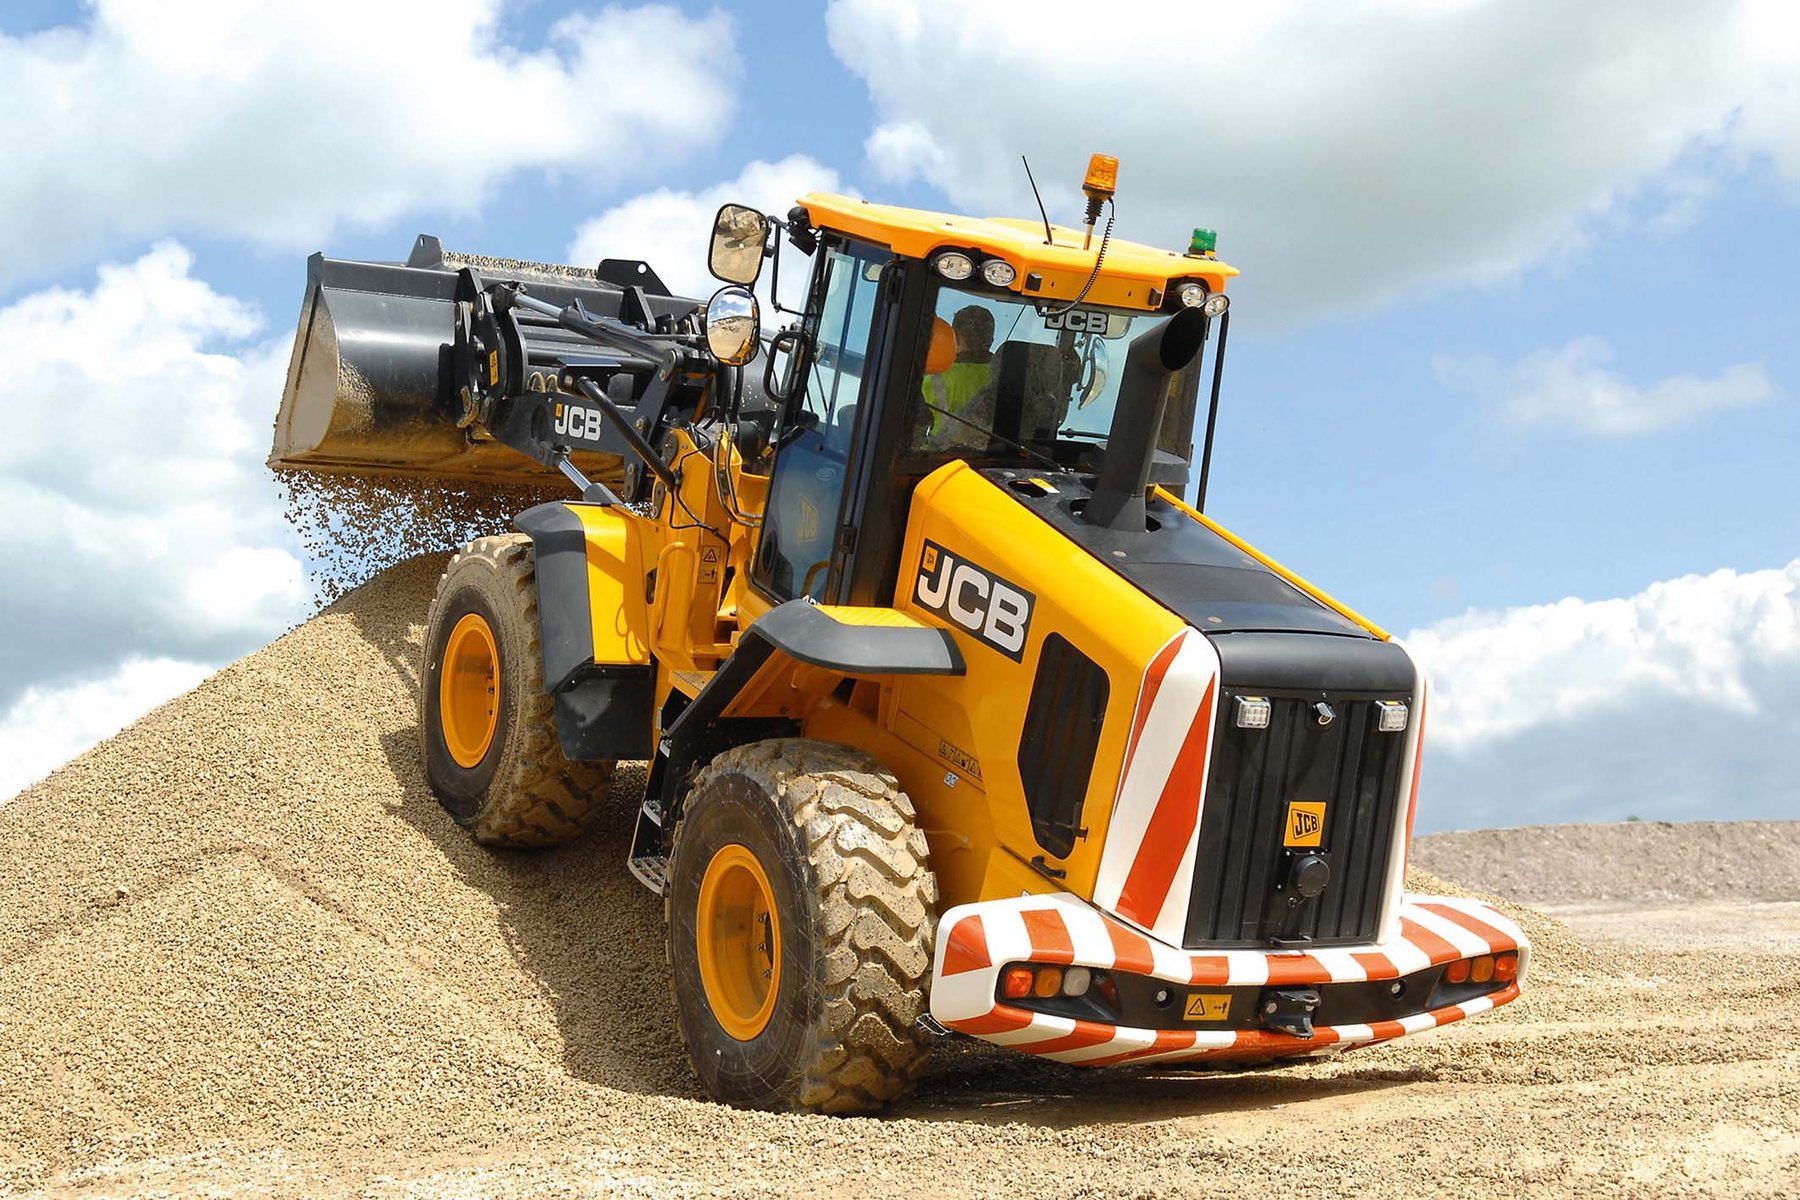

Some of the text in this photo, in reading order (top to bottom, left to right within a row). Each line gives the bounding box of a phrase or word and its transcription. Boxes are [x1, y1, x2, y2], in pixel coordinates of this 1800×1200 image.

[1047, 310, 1108, 333] JCB
[555, 404, 602, 441] JCB
[918, 555, 1029, 652] JCB
[1295, 812, 1318, 836] JCB
